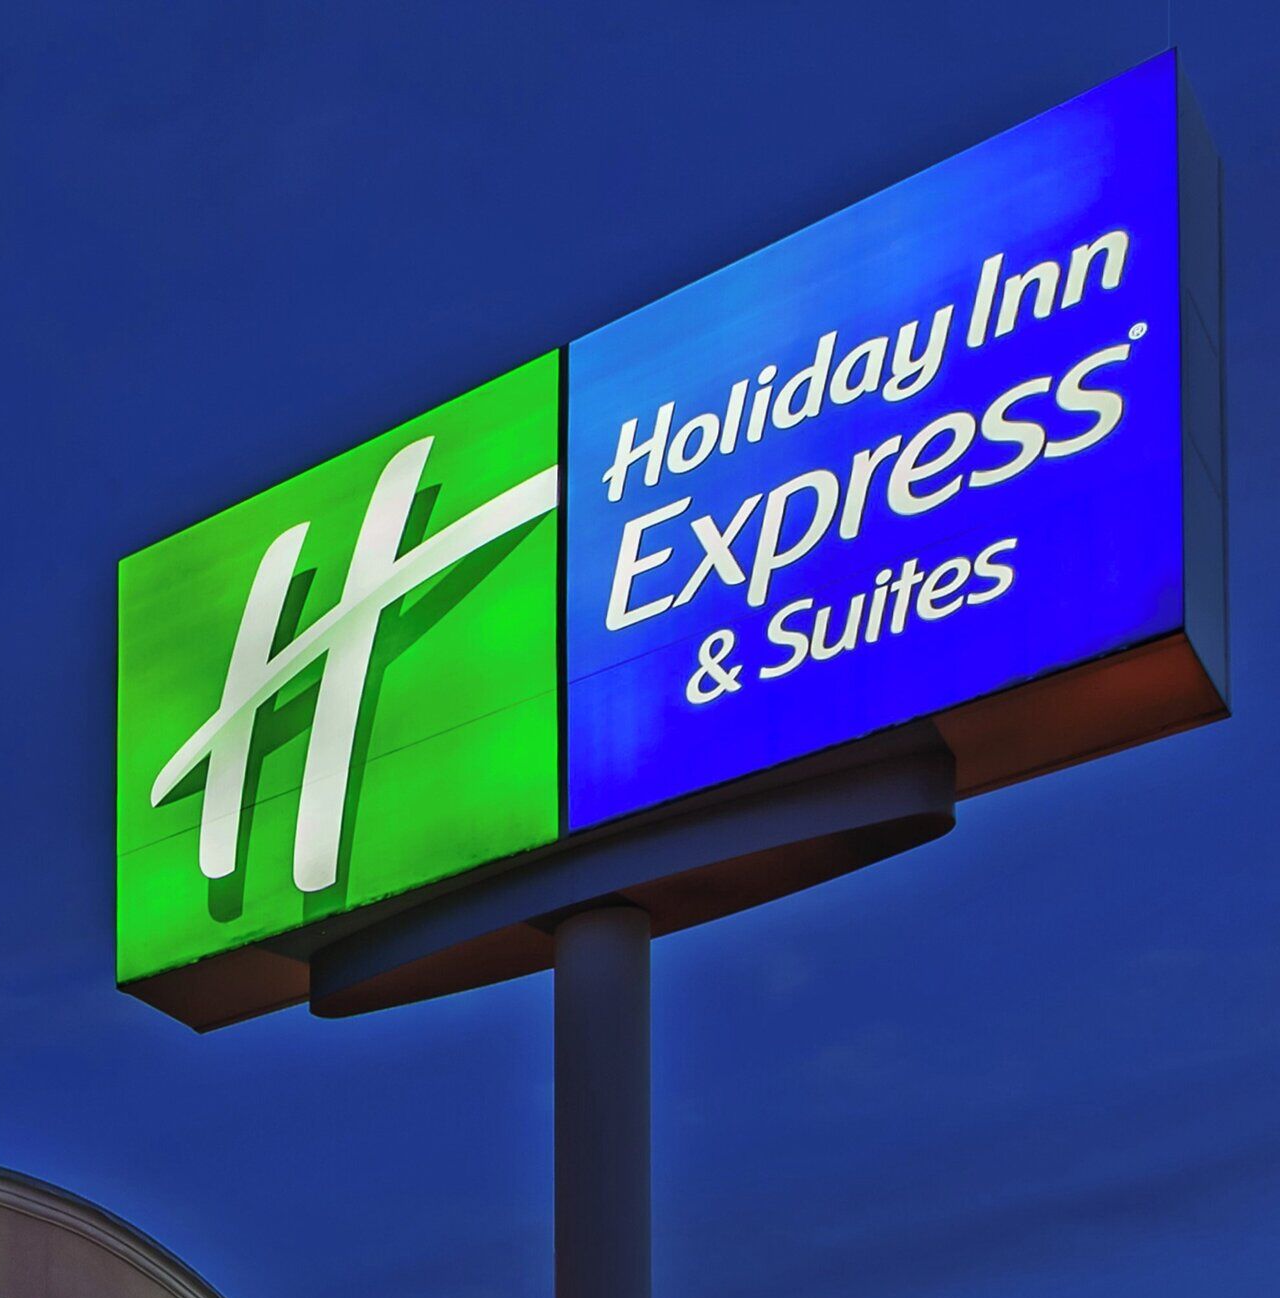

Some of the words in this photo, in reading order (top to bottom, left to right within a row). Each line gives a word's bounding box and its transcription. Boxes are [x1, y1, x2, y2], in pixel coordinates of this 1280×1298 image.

[601, 303, 955, 503] Holiday
[965, 229, 1130, 349] Inn
[685, 628, 744, 705] &
[758, 537, 1019, 680] Suites
